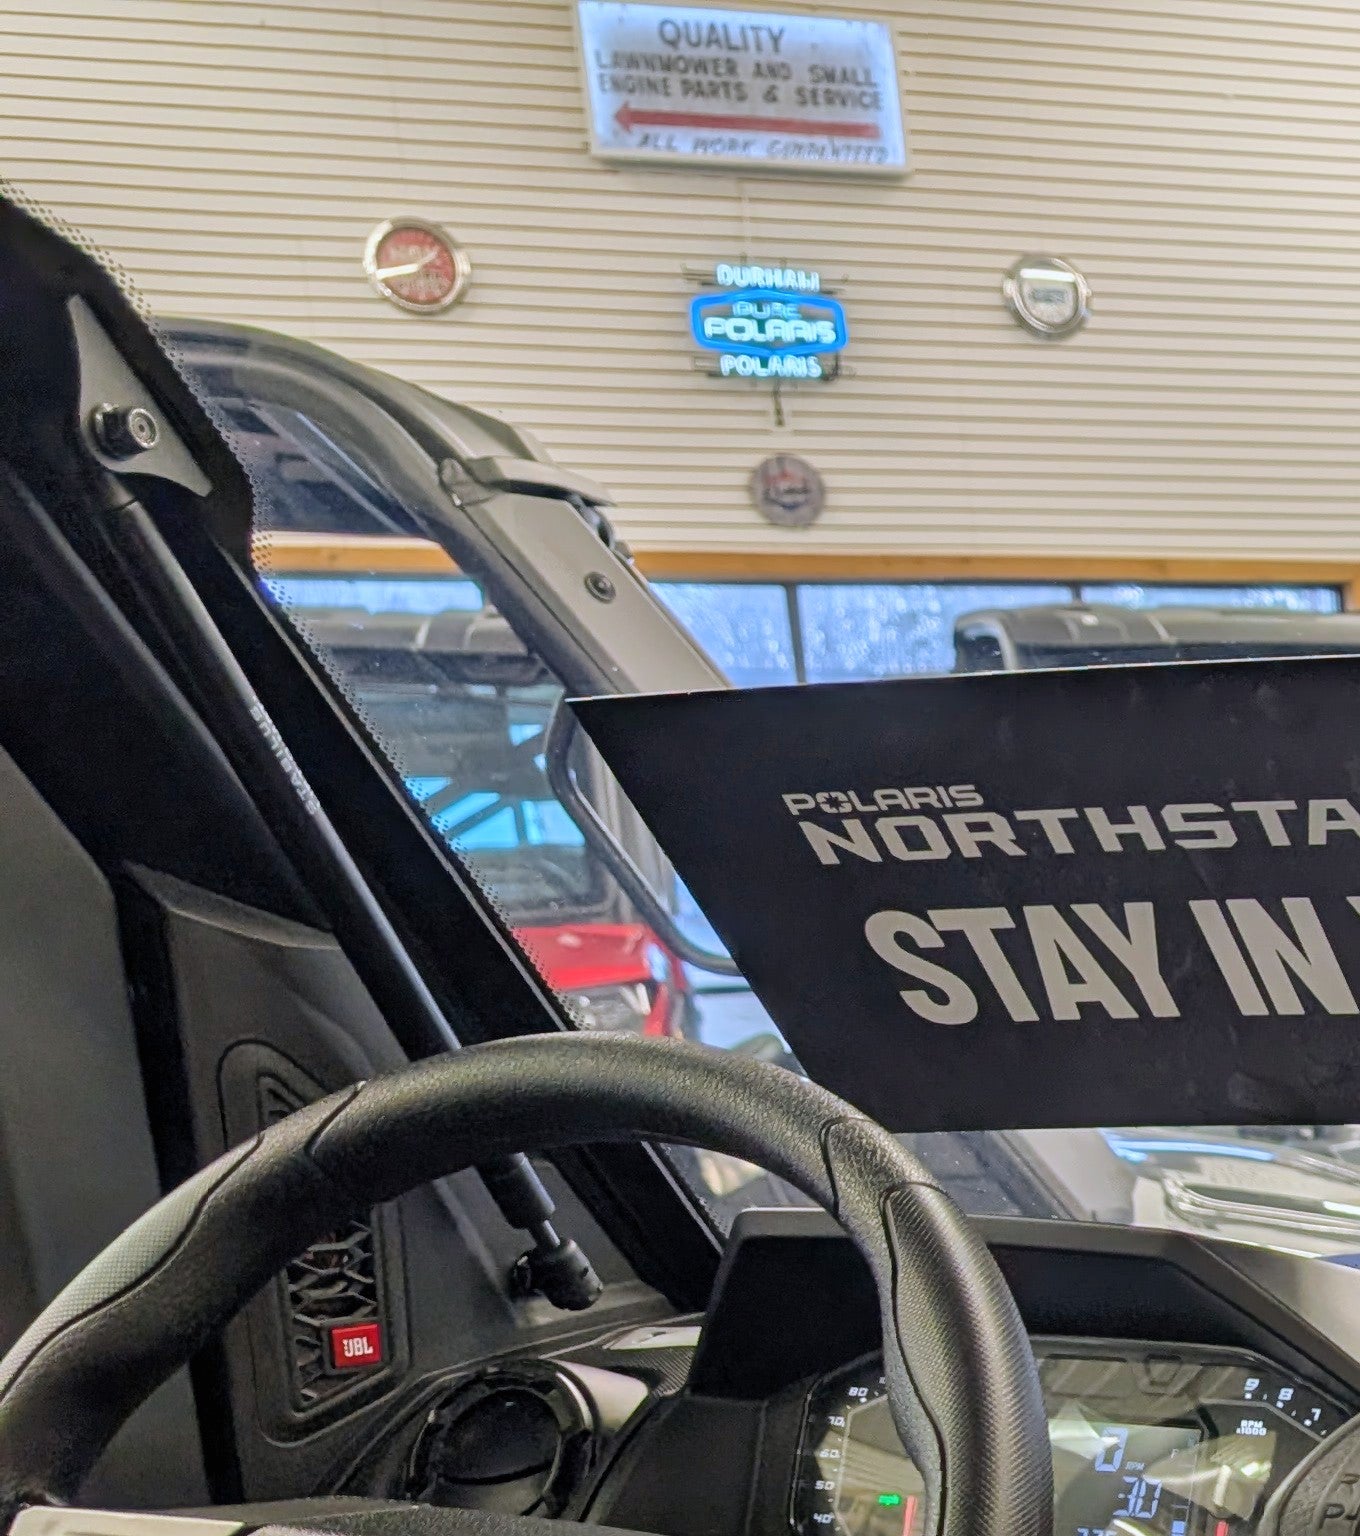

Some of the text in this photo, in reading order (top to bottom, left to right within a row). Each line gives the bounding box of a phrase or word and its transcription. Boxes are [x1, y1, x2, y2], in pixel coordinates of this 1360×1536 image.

[657, 17, 785, 54] QUALITY
[752, 62, 793, 80] AND
[808, 64, 877, 87] SMALL
[600, 74, 671, 98] ENGINE
[681, 80, 747, 102] PARTS
[794, 87, 883, 111] SERVICE
[704, 317, 836, 345] POLARIS
[721, 355, 823, 377] POLARIS
[782, 784, 984, 816] POLARIS
[864, 901, 1181, 1026] STAY
[1189, 896, 1360, 1016] IN
[342, 1336, 374, 1358] JBL
[848, 1386, 869, 1398] 80
[1243, 1378, 1260, 1391] 9
[1278, 1388, 1294, 1401] 8
[1240, 1419, 1264, 1429] RPM
[1310, 1407, 1322, 1421] 7
[815, 1480, 836, 1491] 50
[813, 1512, 836, 1524] 40
